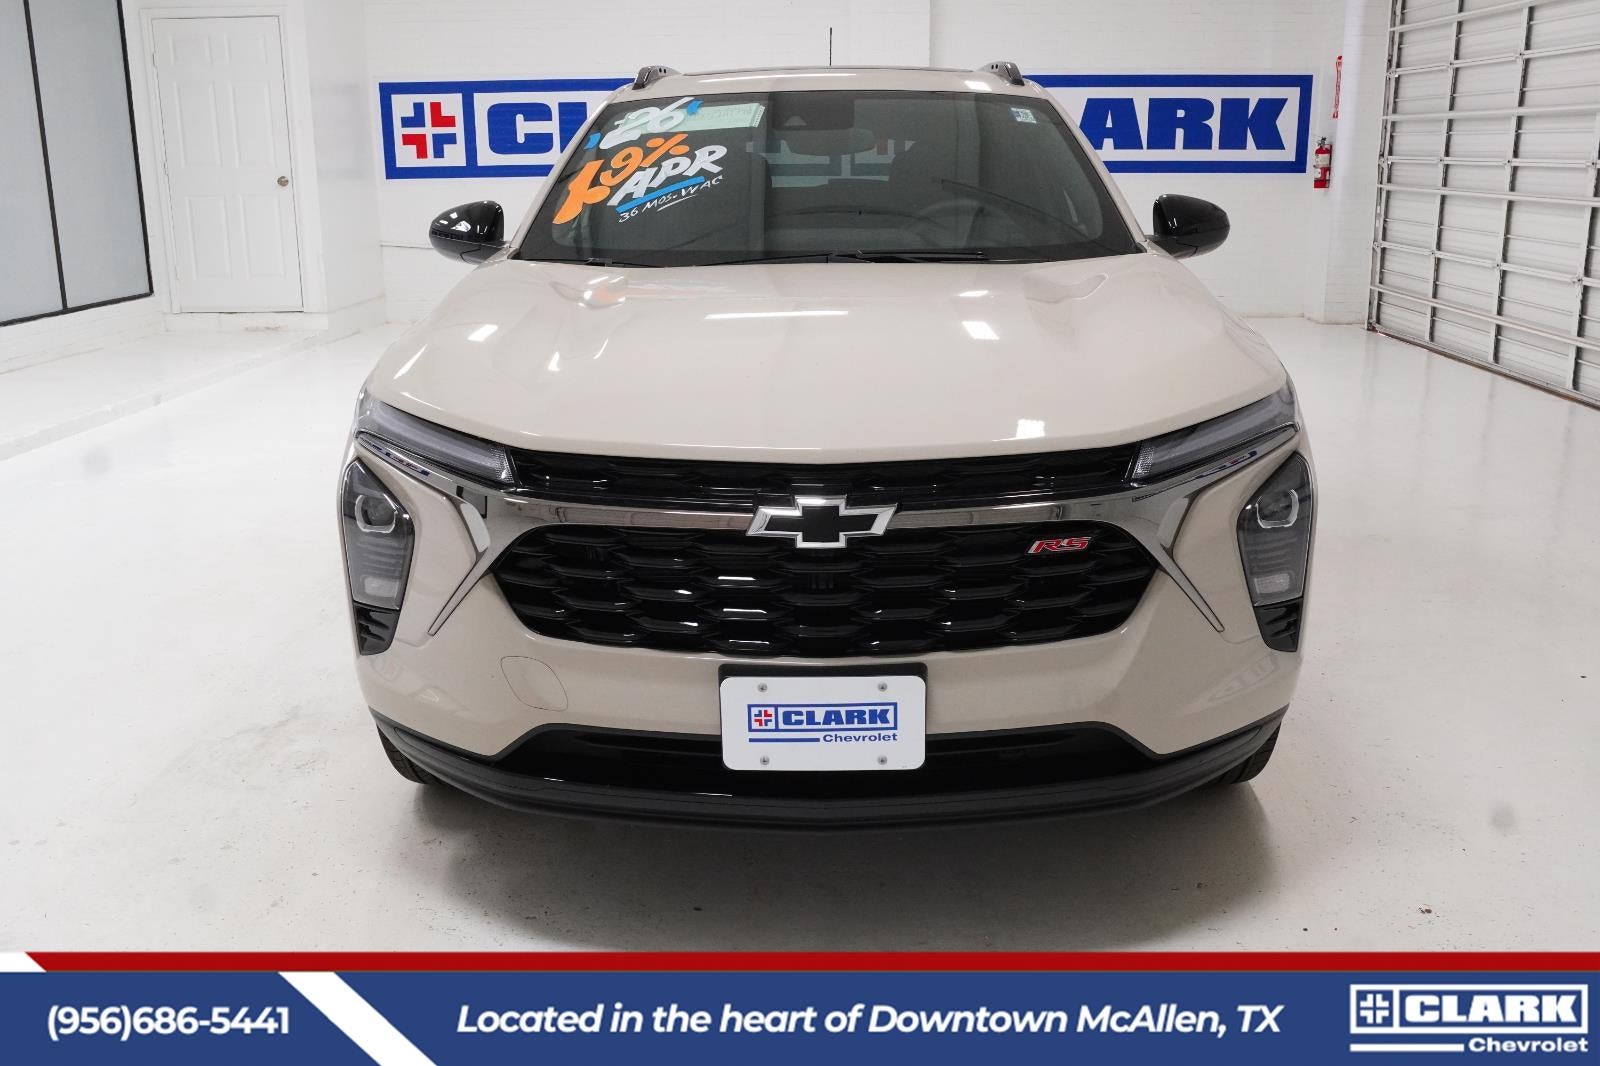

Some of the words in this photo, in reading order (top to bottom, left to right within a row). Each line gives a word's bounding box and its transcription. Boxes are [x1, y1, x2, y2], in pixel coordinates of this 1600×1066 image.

[606, 144, 728, 206] APR
[618, 206, 639, 223] 36
[680, 174, 723, 197] WAC
[1027, 536, 1092, 554] RS
[782, 708, 891, 726] CLARK
[822, 732, 899, 743] Chevrolet
